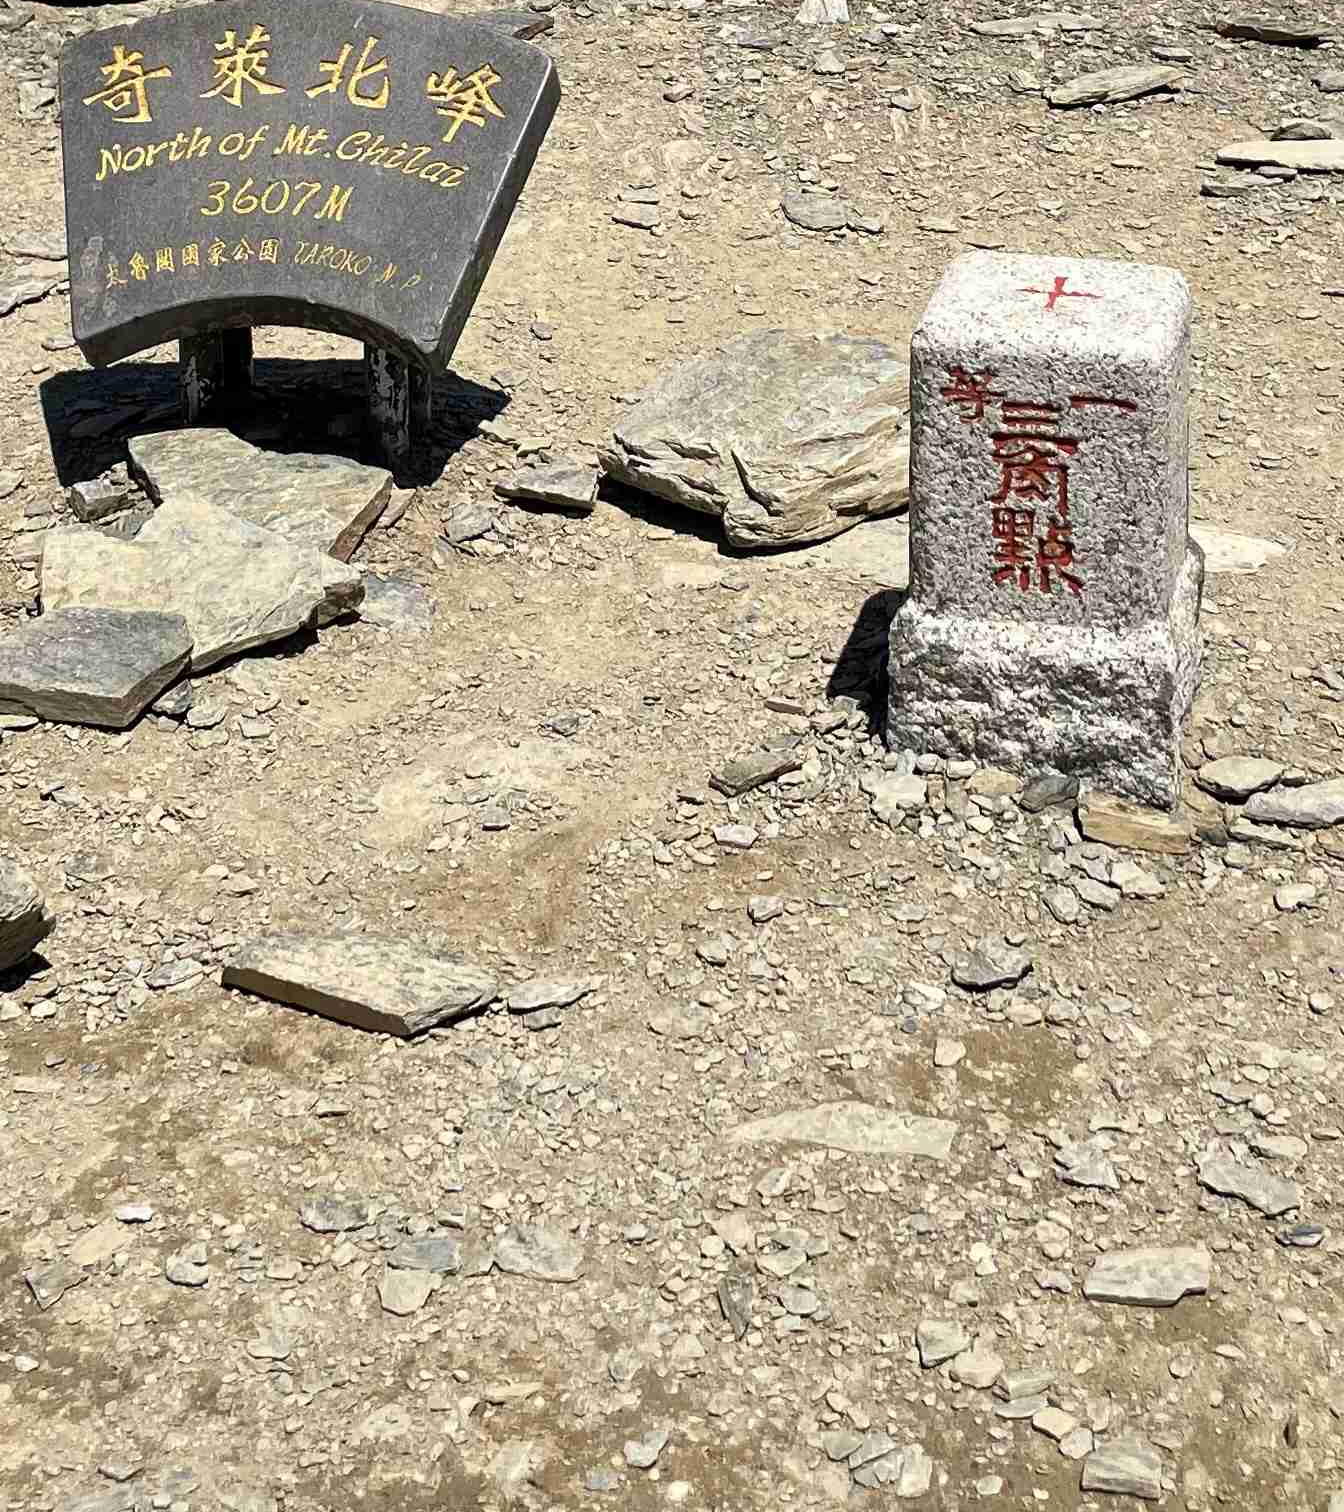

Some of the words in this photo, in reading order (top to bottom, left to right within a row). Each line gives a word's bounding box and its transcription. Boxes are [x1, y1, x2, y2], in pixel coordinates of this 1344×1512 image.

[82, 22, 507, 144] 奇萊北峰
[95, 127, 212, 182] North
[218, 123, 269, 161] of
